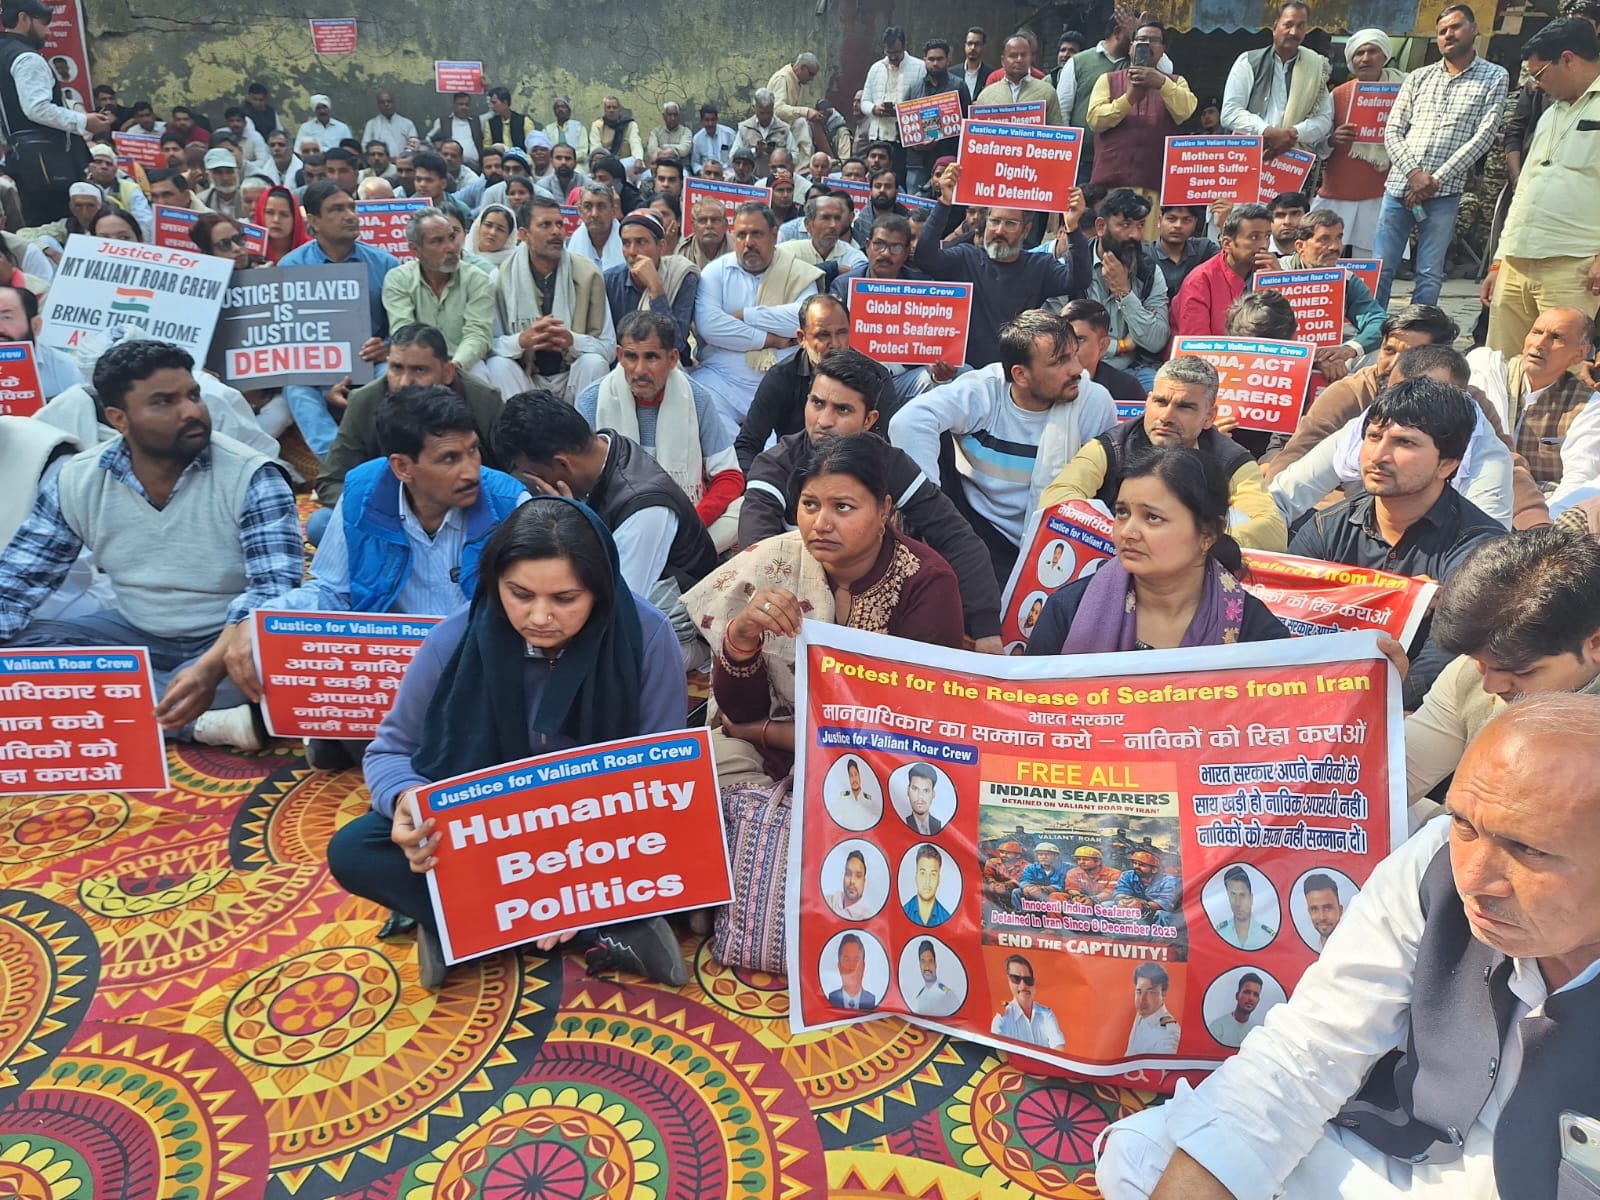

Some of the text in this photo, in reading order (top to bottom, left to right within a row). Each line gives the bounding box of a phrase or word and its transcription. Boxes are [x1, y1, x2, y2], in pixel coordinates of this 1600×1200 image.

[970, 126, 997, 134] Justice
[1010, 129, 1035, 137] Valiant
[1037, 130, 1054, 138] Roar
[1055, 132, 1075, 140] Crew
[1360, 126, 1376, 137] Not
[968, 140, 1072, 161] Seafarers Deserve
[1182, 151, 1247, 162] Mothers Cry,
[1294, 154, 1309, 162] Crew
[995, 162, 1038, 182] Dignity,
[1170, 164, 1248, 174] Families Suffer
[1271, 158, 1304, 176] Deserve
[1190, 176, 1238, 186] Save Our
[975, 182, 1053, 202] Not Detention
[1187, 190, 1238, 200] Seafarers
[97, 242, 200, 269] Justice For
[60, 256, 222, 301] MT VALIANT ROAR CREW
[222, 280, 360, 308] USTICE DELAYED
[867, 284, 955, 296] Valiant Roar Crew
[274, 303, 294, 322] IS
[866, 299, 952, 319] Global Shipping
[51, 304, 202, 344] BRING THEM HOME
[856, 320, 882, 334] Runs
[886, 323, 899, 334] on
[1305, 320, 1334, 331] OUR
[242, 322, 330, 346] JUSTICE
[1297, 332, 1337, 343] HOME
[869, 340, 942, 356] Protect Them
[1184, 342, 1212, 350] Justice
[1228, 343, 1256, 352] Valiant
[1258, 345, 1278, 354] Roar
[1280, 348, 1303, 356] Crew
[234, 346, 342, 376] DENIED
[1251, 358, 1296, 372] ACT
[1247, 374, 1293, 390] OUR
[1218, 389, 1292, 406] FARERS
[1238, 406, 1280, 422] YOU
[1049, 518, 1103, 549] Justice for Valiant
[1324, 569, 1409, 589] from Iran
[270, 620, 429, 636] Justice for Valiant Roa
[302, 641, 361, 655] भारत
[3, 658, 134, 671] Valiant Roar Crew
[285, 657, 344, 671] अपने
[269, 674, 317, 687] साथ
[821, 656, 1370, 706] Protest for the Release of Seafarers from Iran
[101, 684, 142, 699] का
[50, 710, 104, 730] करो
[822, 704, 1367, 750] मानवाधिकार का सम्मान करो नाविकों को रिहा कराओं
[1028, 712, 1125, 727] भारत सरकार
[78, 738, 118, 758] को
[822, 731, 972, 762] Justice for Valiant Roar Crew
[437, 744, 693, 807] Justice for Valiant Roar Crew
[1016, 762, 1140, 788] FREE ALL
[1200, 765, 1230, 782] भारत
[1233, 764, 1274, 782] सरकार
[1278, 756, 1308, 782] अपने
[1347, 757, 1358, 783] के
[990, 784, 1170, 806] INDIAN SEAFARERS
[1194, 796, 1218, 814] साथ
[1248, 788, 1262, 814] हो
[1264, 788, 1302, 815] नाविक
[1303, 790, 1338, 816] अपराधी
[1002, 798, 1042, 807] DETAINED
[1058, 802, 1095, 810] VALIANT
[1098, 804, 1122, 812] ROAR
[448, 780, 696, 850] Humanity
[1038, 834, 1074, 842] VALIANT
[1198, 820, 1242, 845] नाविकों
[1245, 821, 1261, 846] को
[1307, 830, 1346, 850] सम्मान
[496, 832, 666, 885] Before
[494, 874, 684, 932] Politics
[1064, 902, 1093, 915] Indian
[992, 910, 1031, 926] Detained
[1043, 916, 1062, 929] Iran
[1063, 917, 1090, 932] Since
[1092, 920, 1098, 932] 8
[1100, 920, 1150, 936] December
[1152, 924, 1178, 938] 2025
[998, 934, 1168, 961] END THE CAPTIVITY!
